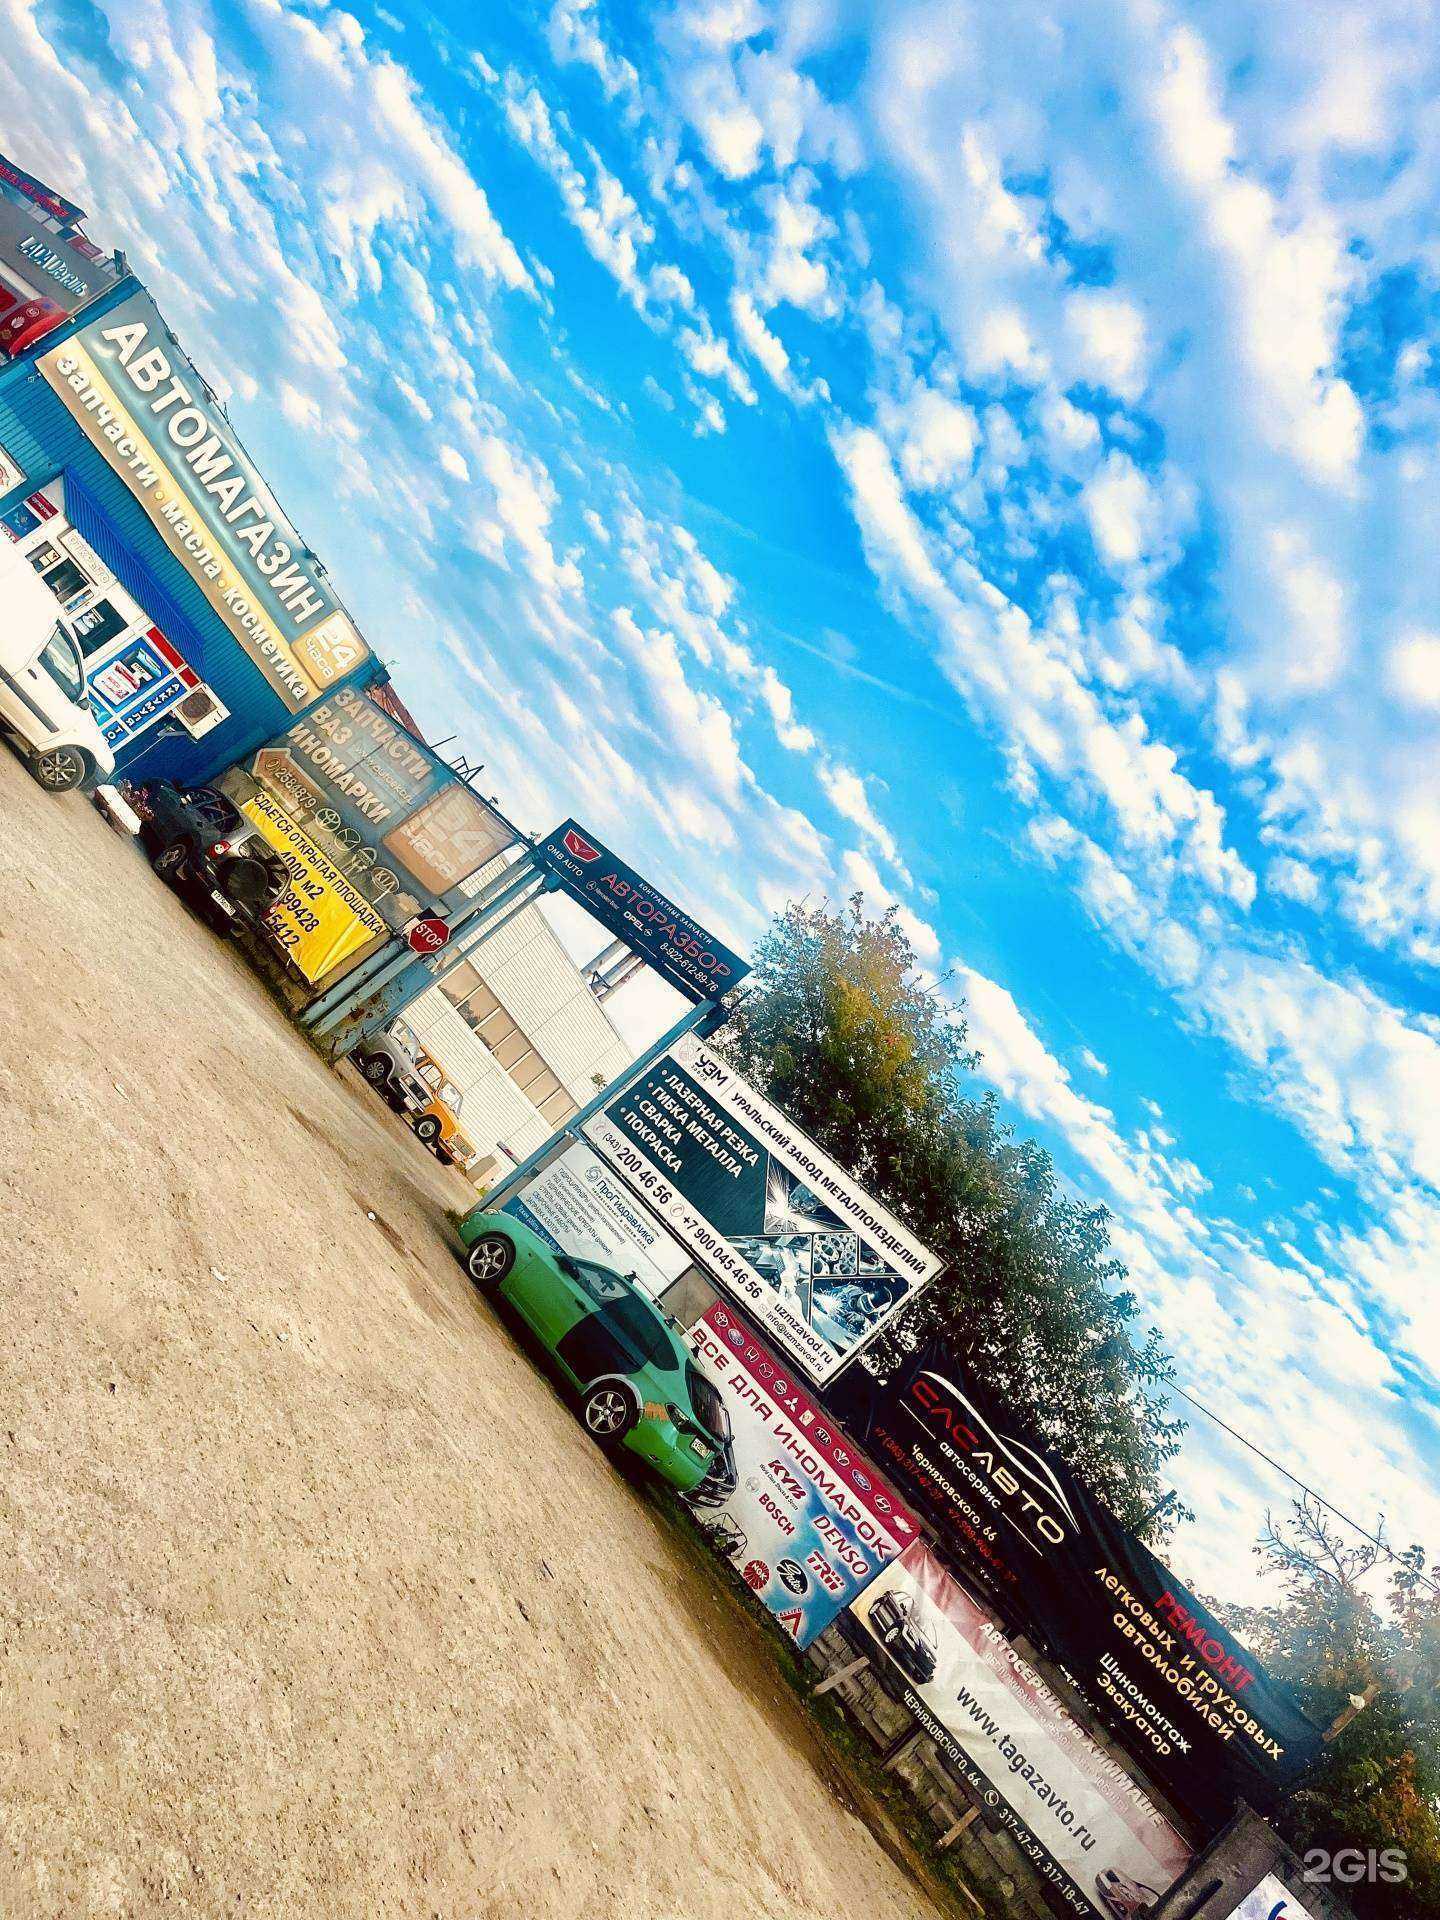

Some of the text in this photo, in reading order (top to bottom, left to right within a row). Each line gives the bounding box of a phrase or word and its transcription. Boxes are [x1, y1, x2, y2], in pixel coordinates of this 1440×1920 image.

[100, 323, 325, 623] АВТОМАГАЗИН
[54, 354, 309, 701] запчасти масла косметика
[300, 638, 336, 679] часа
[313, 620, 359, 670] 24
[309, 704, 353, 747] ВАЗ
[332, 686, 431, 781] ЗАПЧАСТИ
[273, 765, 317, 810] 2584879
[286, 723, 391, 824] ИНОМАРКИ
[287, 829, 337, 884] ОТКРЫТАЯ
[330, 879, 383, 938] ПЛОЩАДКА
[299, 880, 324, 900] м2
[373, 868, 397, 893] KIA
[562, 858, 583, 876] AUTO
[414, 921, 443, 950] STOP
[600, 872, 731, 981] АВТОРАЗБОР
[623, 910, 645, 930] OPEL
[638, 883, 712, 945] КОНТРАКТНЫЕ ЗАПЧАСТИ
[659, 942, 718, 993] 8-922-612-89-76
[694, 1054, 728, 1087] УЗМ
[622, 1111, 682, 1173] ПОКРАСКА
[637, 1099, 682, 1145] СВАРКА
[651, 1086, 742, 1178] ГИБКА МЕТАЛЛА
[664, 1074, 760, 1167] ЛАЗЕРНАЯ РЕЗКА
[595, 1180, 654, 1245] ПроГидравлика
[729, 1092, 927, 1274] УРАЛЬСКИЙ ЗАВОД МЕТАЛЛОИЗДЕЛИЙ
[553, 1215, 570, 1233] РАБОТЫ
[576, 1215, 597, 1237] АГРЕГАТЫ
[601, 1131, 763, 1300] (343) 200 46 56 +7 900 045 46 56
[763, 1311, 824, 1372] info@uzmzavod.ru
[773, 1302, 834, 1364] uzmzavod.ru
[691, 1328, 892, 1560] ВСЕ ДЛЯ ИНОМАРОК
[815, 1429, 830, 1443] KIA
[767, 1459, 808, 1500] KYB
[909, 1444, 998, 1542] Черняховского, 66
[938, 1441, 1001, 1509] автосервис
[758, 1492, 795, 1535] BOSCH
[751, 1562, 766, 1580] NGK
[806, 1550, 846, 1591] TRW
[813, 1515, 870, 1575] DENSO
[1093, 1566, 1284, 1760] легковых и грузовых
[1153, 1590, 1256, 1693] РЕМОНТ
[1098, 1652, 1193, 1754] Шиномонтаж
[1111, 1612, 1238, 1740] автомобилей
[977, 1622, 1166, 1827] АВТОСЕРВИС на ХИММАШЕ
[1095, 1672, 1172, 1756] Эвакуатор
[956, 1684, 1097, 1851] www.tagazavto.ru
[899, 1689, 1090, 1916] ЧЕРНЯХОВСКОГО, 66 317-47-37, 317-18-47
